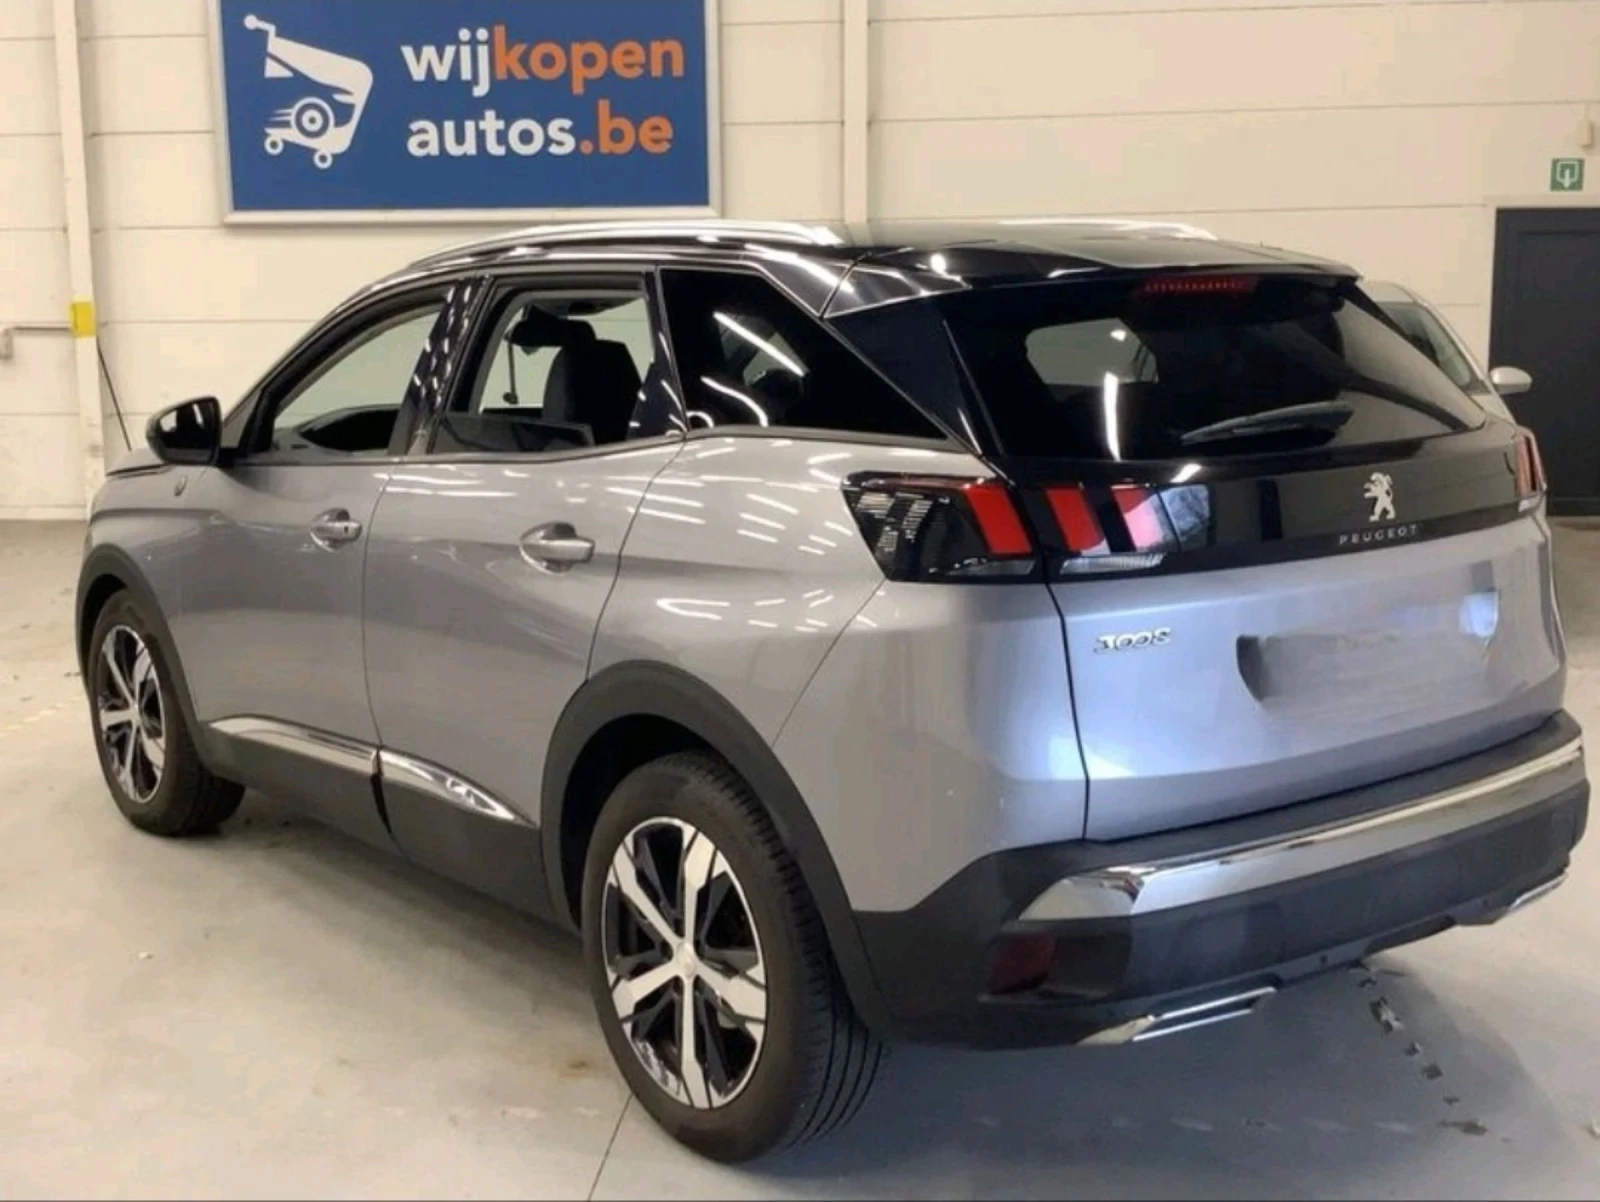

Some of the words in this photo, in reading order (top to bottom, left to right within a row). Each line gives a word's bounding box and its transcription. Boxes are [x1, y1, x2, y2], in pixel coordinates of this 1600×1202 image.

[402, 24, 684, 97] wijkopen
[407, 99, 673, 157] autos.be
[1339, 524, 1418, 545] PEUGEOT
